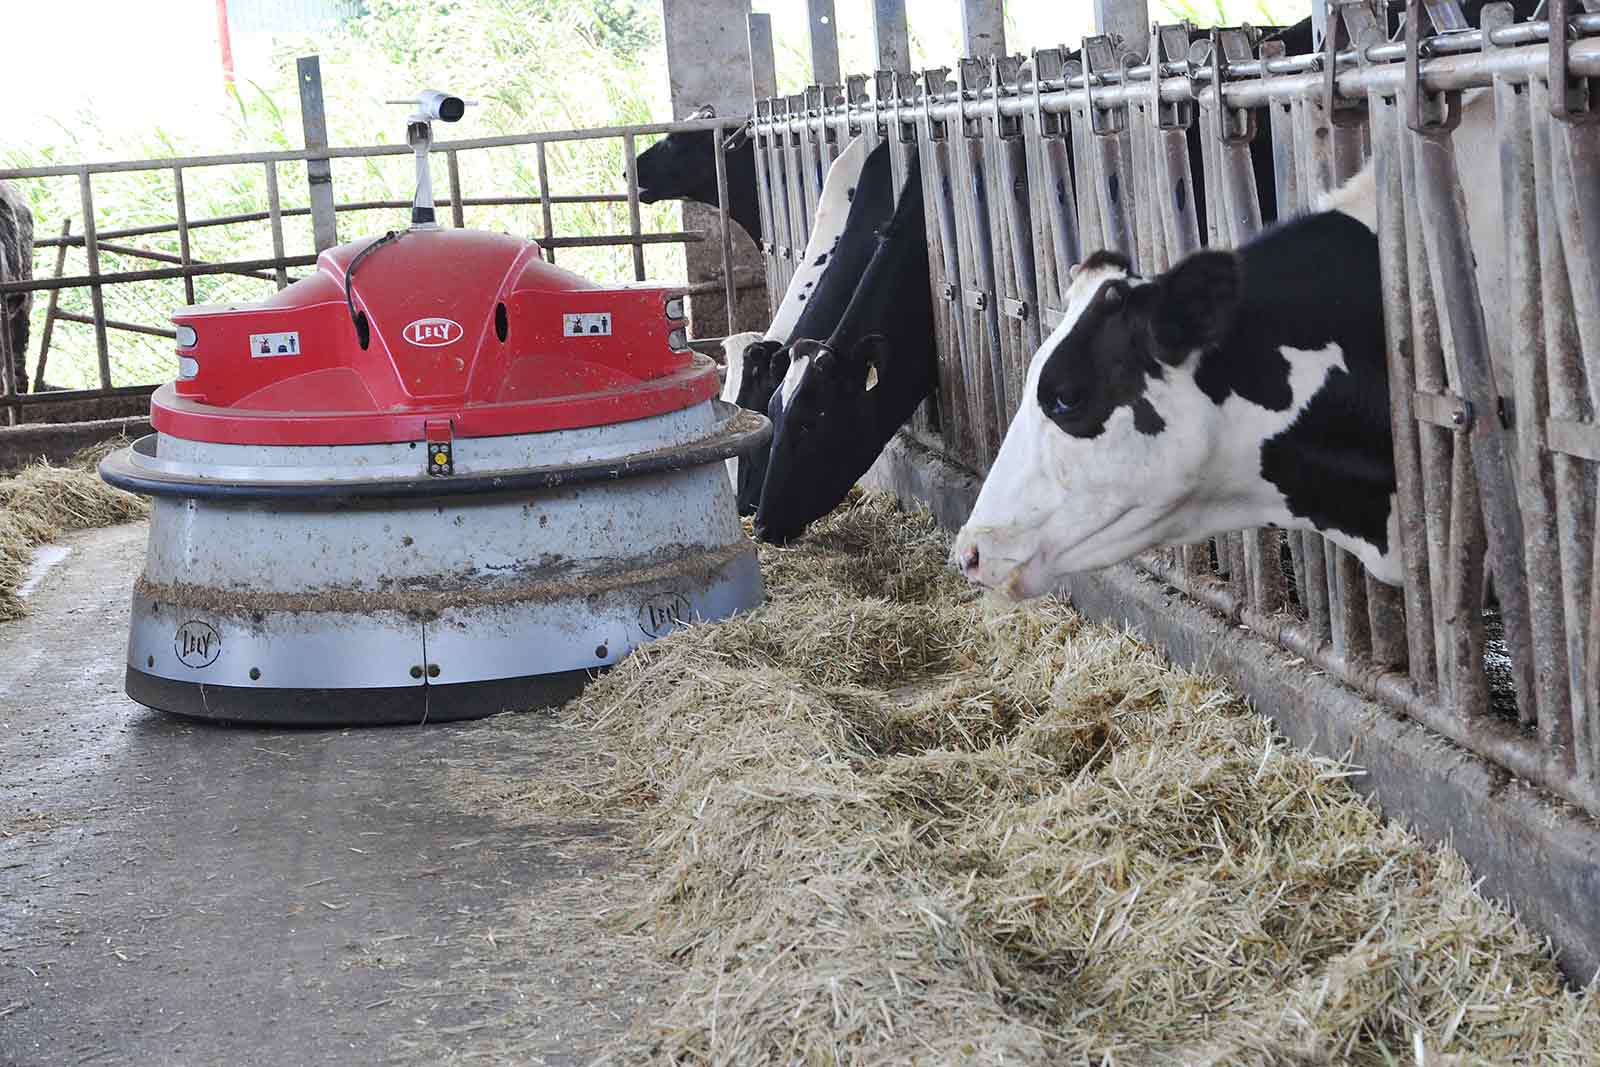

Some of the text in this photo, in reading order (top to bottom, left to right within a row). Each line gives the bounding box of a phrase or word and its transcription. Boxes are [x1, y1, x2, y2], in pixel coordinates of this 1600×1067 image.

[415, 321, 450, 342] LELY
[648, 599, 681, 632] LELY
[182, 630, 211, 658] LELY
